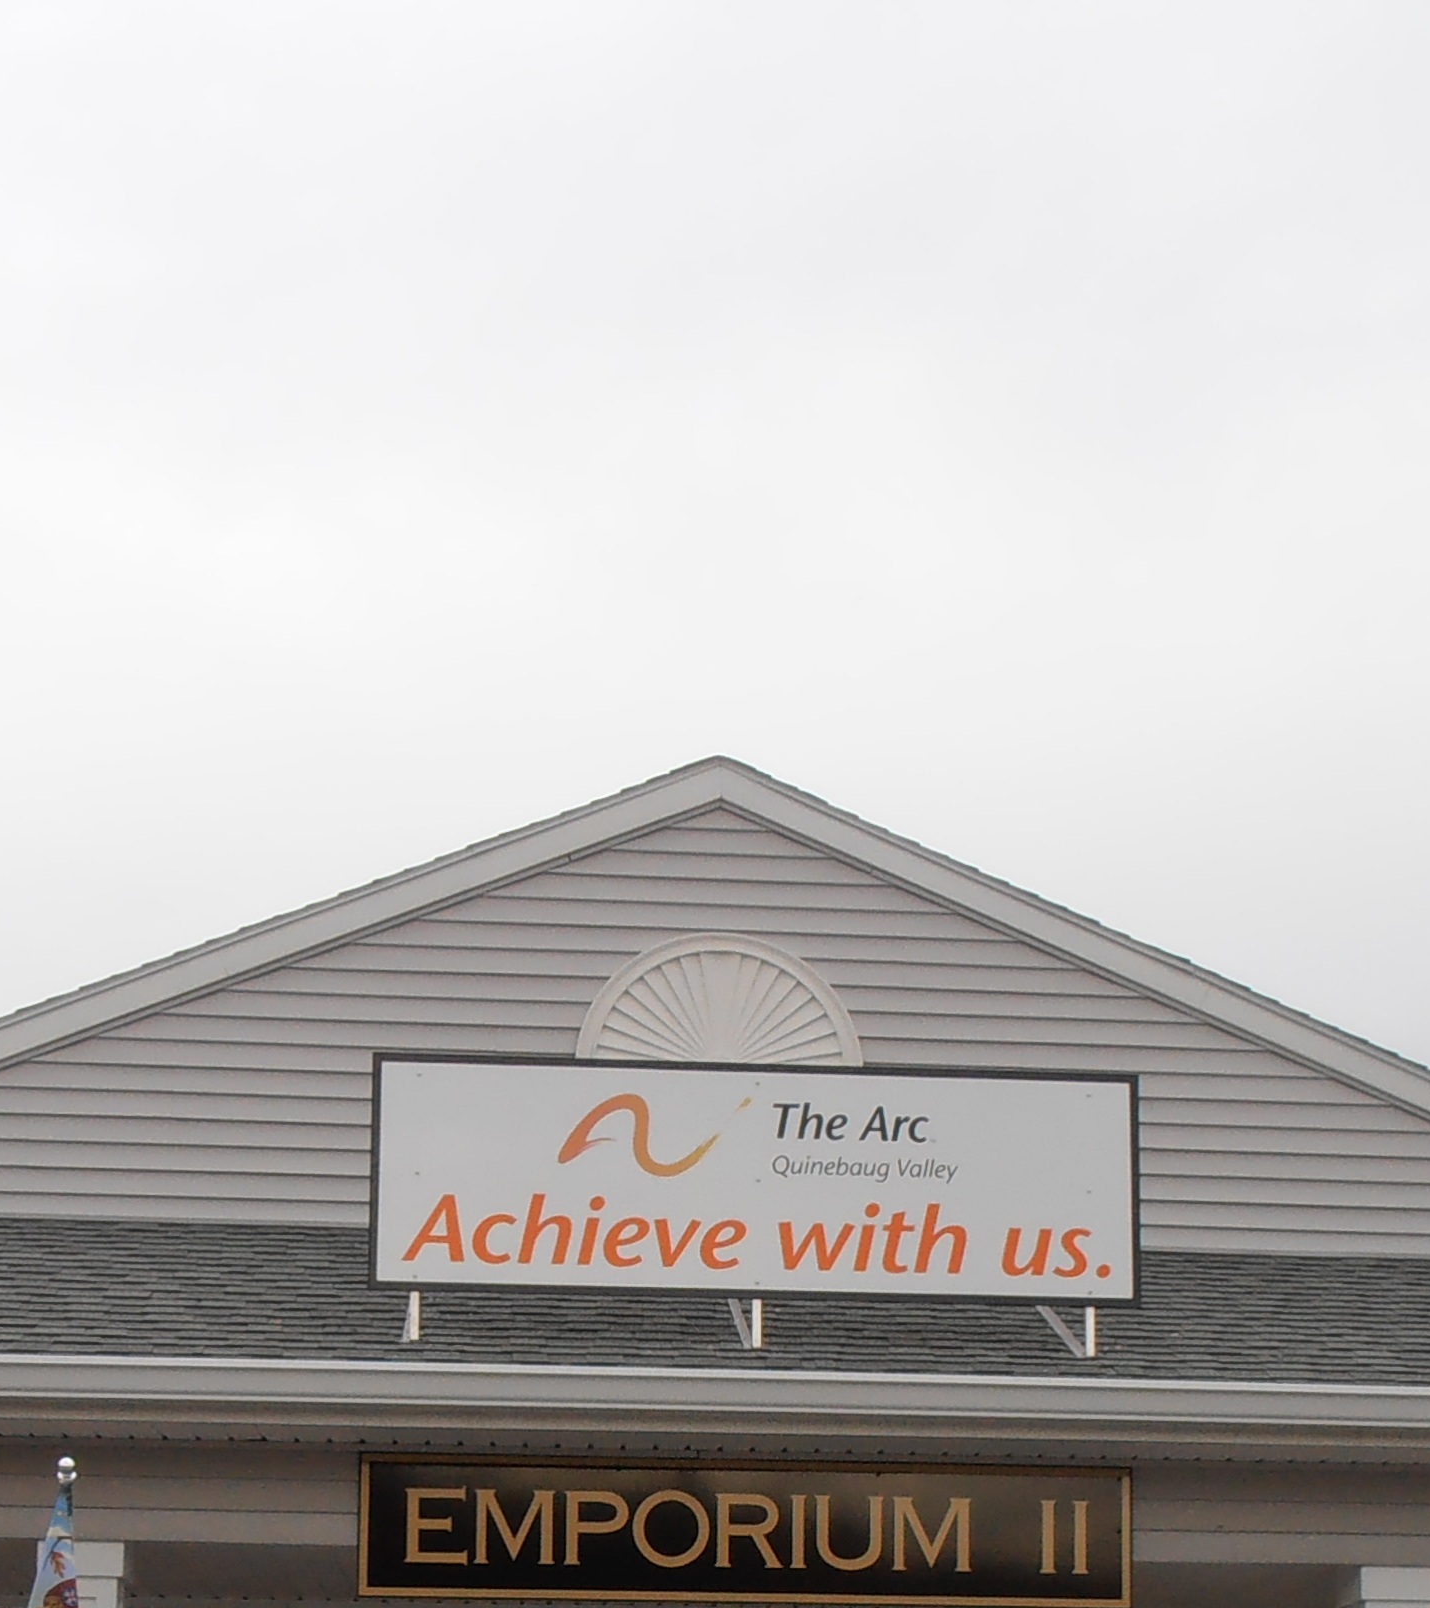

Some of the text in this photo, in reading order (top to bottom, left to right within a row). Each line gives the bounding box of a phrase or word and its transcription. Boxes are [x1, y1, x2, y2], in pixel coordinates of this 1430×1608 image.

[772, 1102, 930, 1144] The Arc
[771, 1154, 959, 1185] Quinebaug Valley
[402, 1194, 1113, 1280] Achieve with us.
[404, 1485, 1090, 1576] EMPORIUM II
